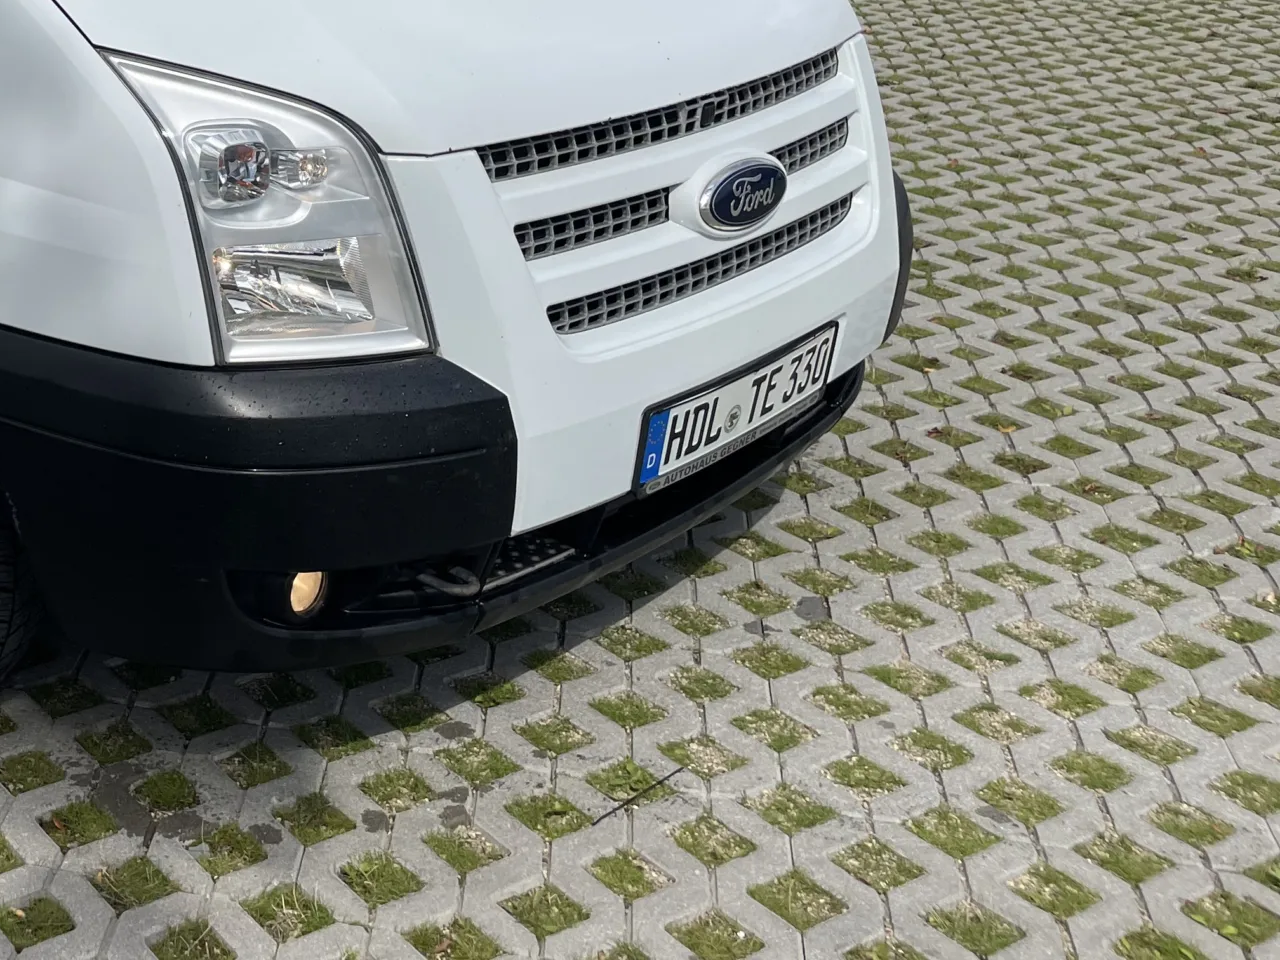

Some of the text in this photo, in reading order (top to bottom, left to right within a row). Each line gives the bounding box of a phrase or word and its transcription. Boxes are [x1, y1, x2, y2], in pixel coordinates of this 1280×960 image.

[730, 173, 775, 216] Ford
[663, 397, 722, 466] HDL
[747, 365, 784, 424] TE
[782, 337, 830, 403] 330
[646, 453, 657, 469] D
[663, 431, 757, 487] AUTOHAUS GEGNER
